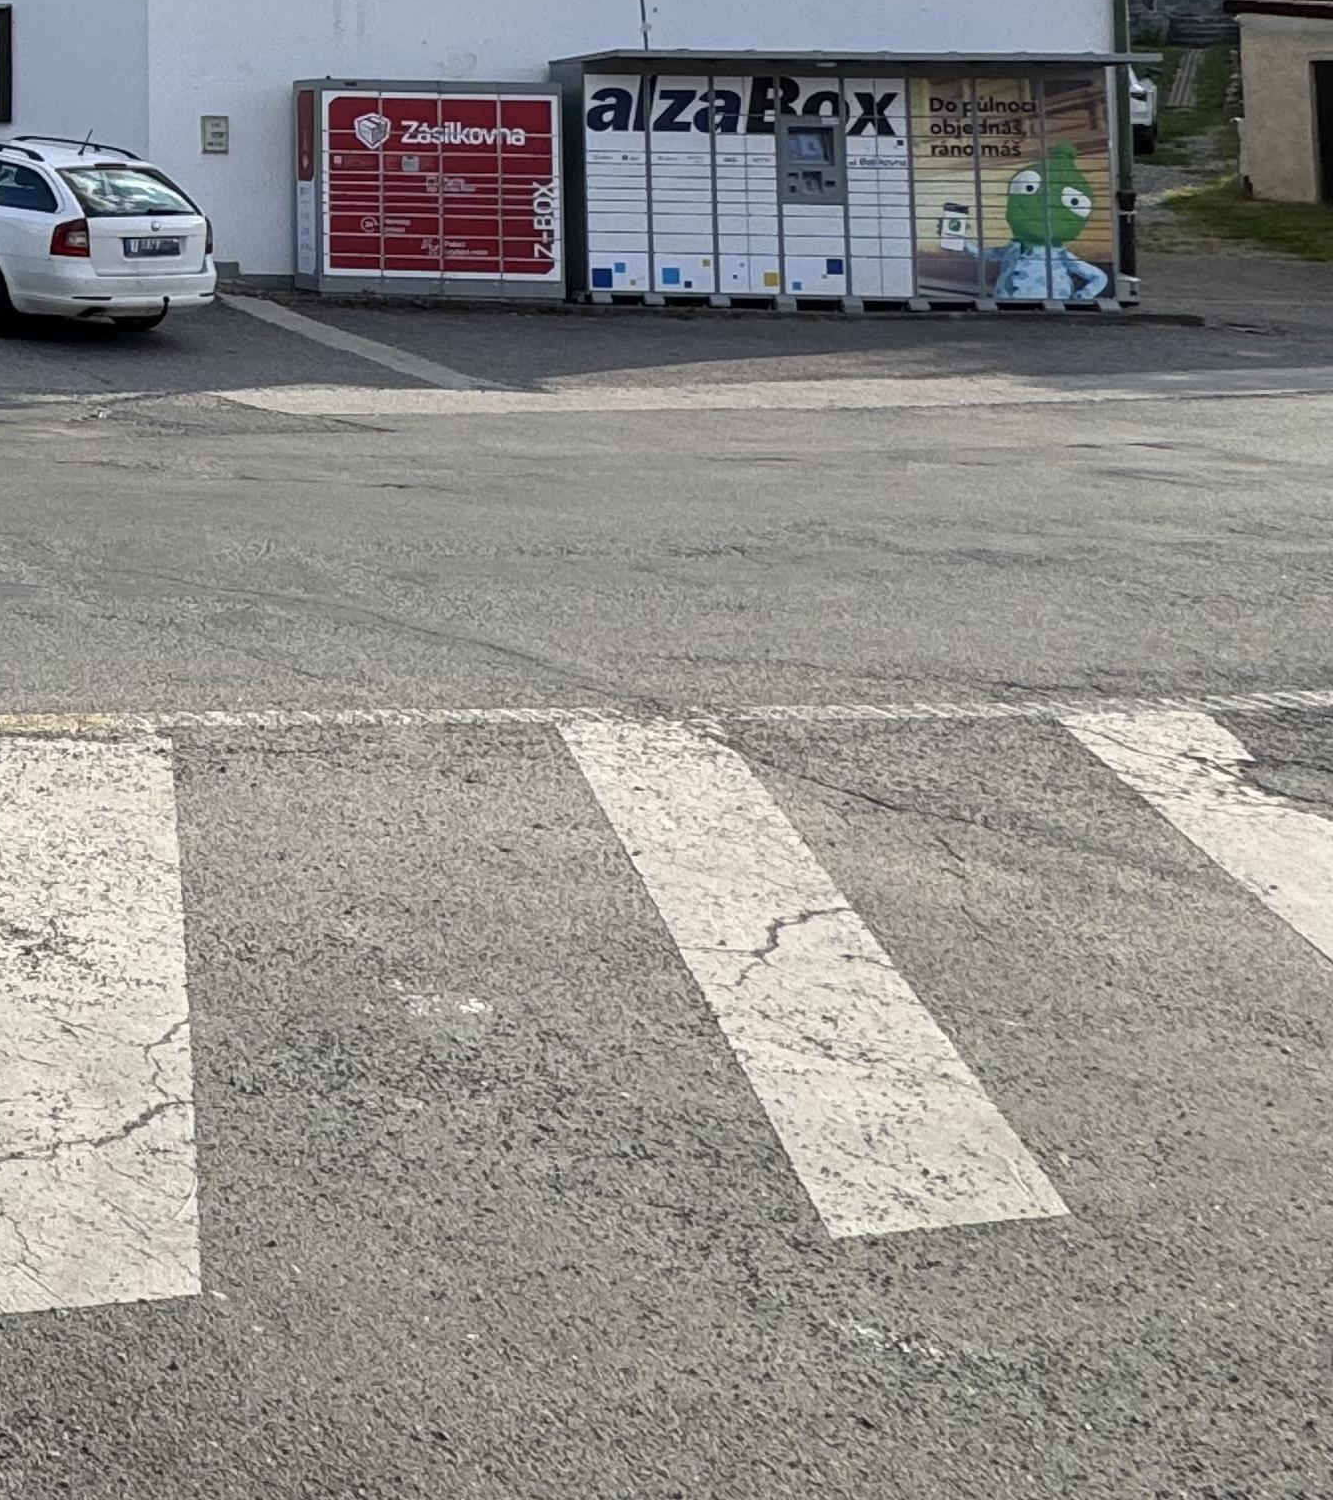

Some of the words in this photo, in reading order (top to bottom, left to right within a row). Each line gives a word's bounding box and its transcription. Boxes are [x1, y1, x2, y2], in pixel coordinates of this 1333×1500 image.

[586, 75, 900, 137] alzaBox
[929, 97, 963, 113] Do
[400, 119, 527, 146] Zásilkovna
[981, 139, 1022, 157] máš
[533, 181, 555, 259] Z-BOX
